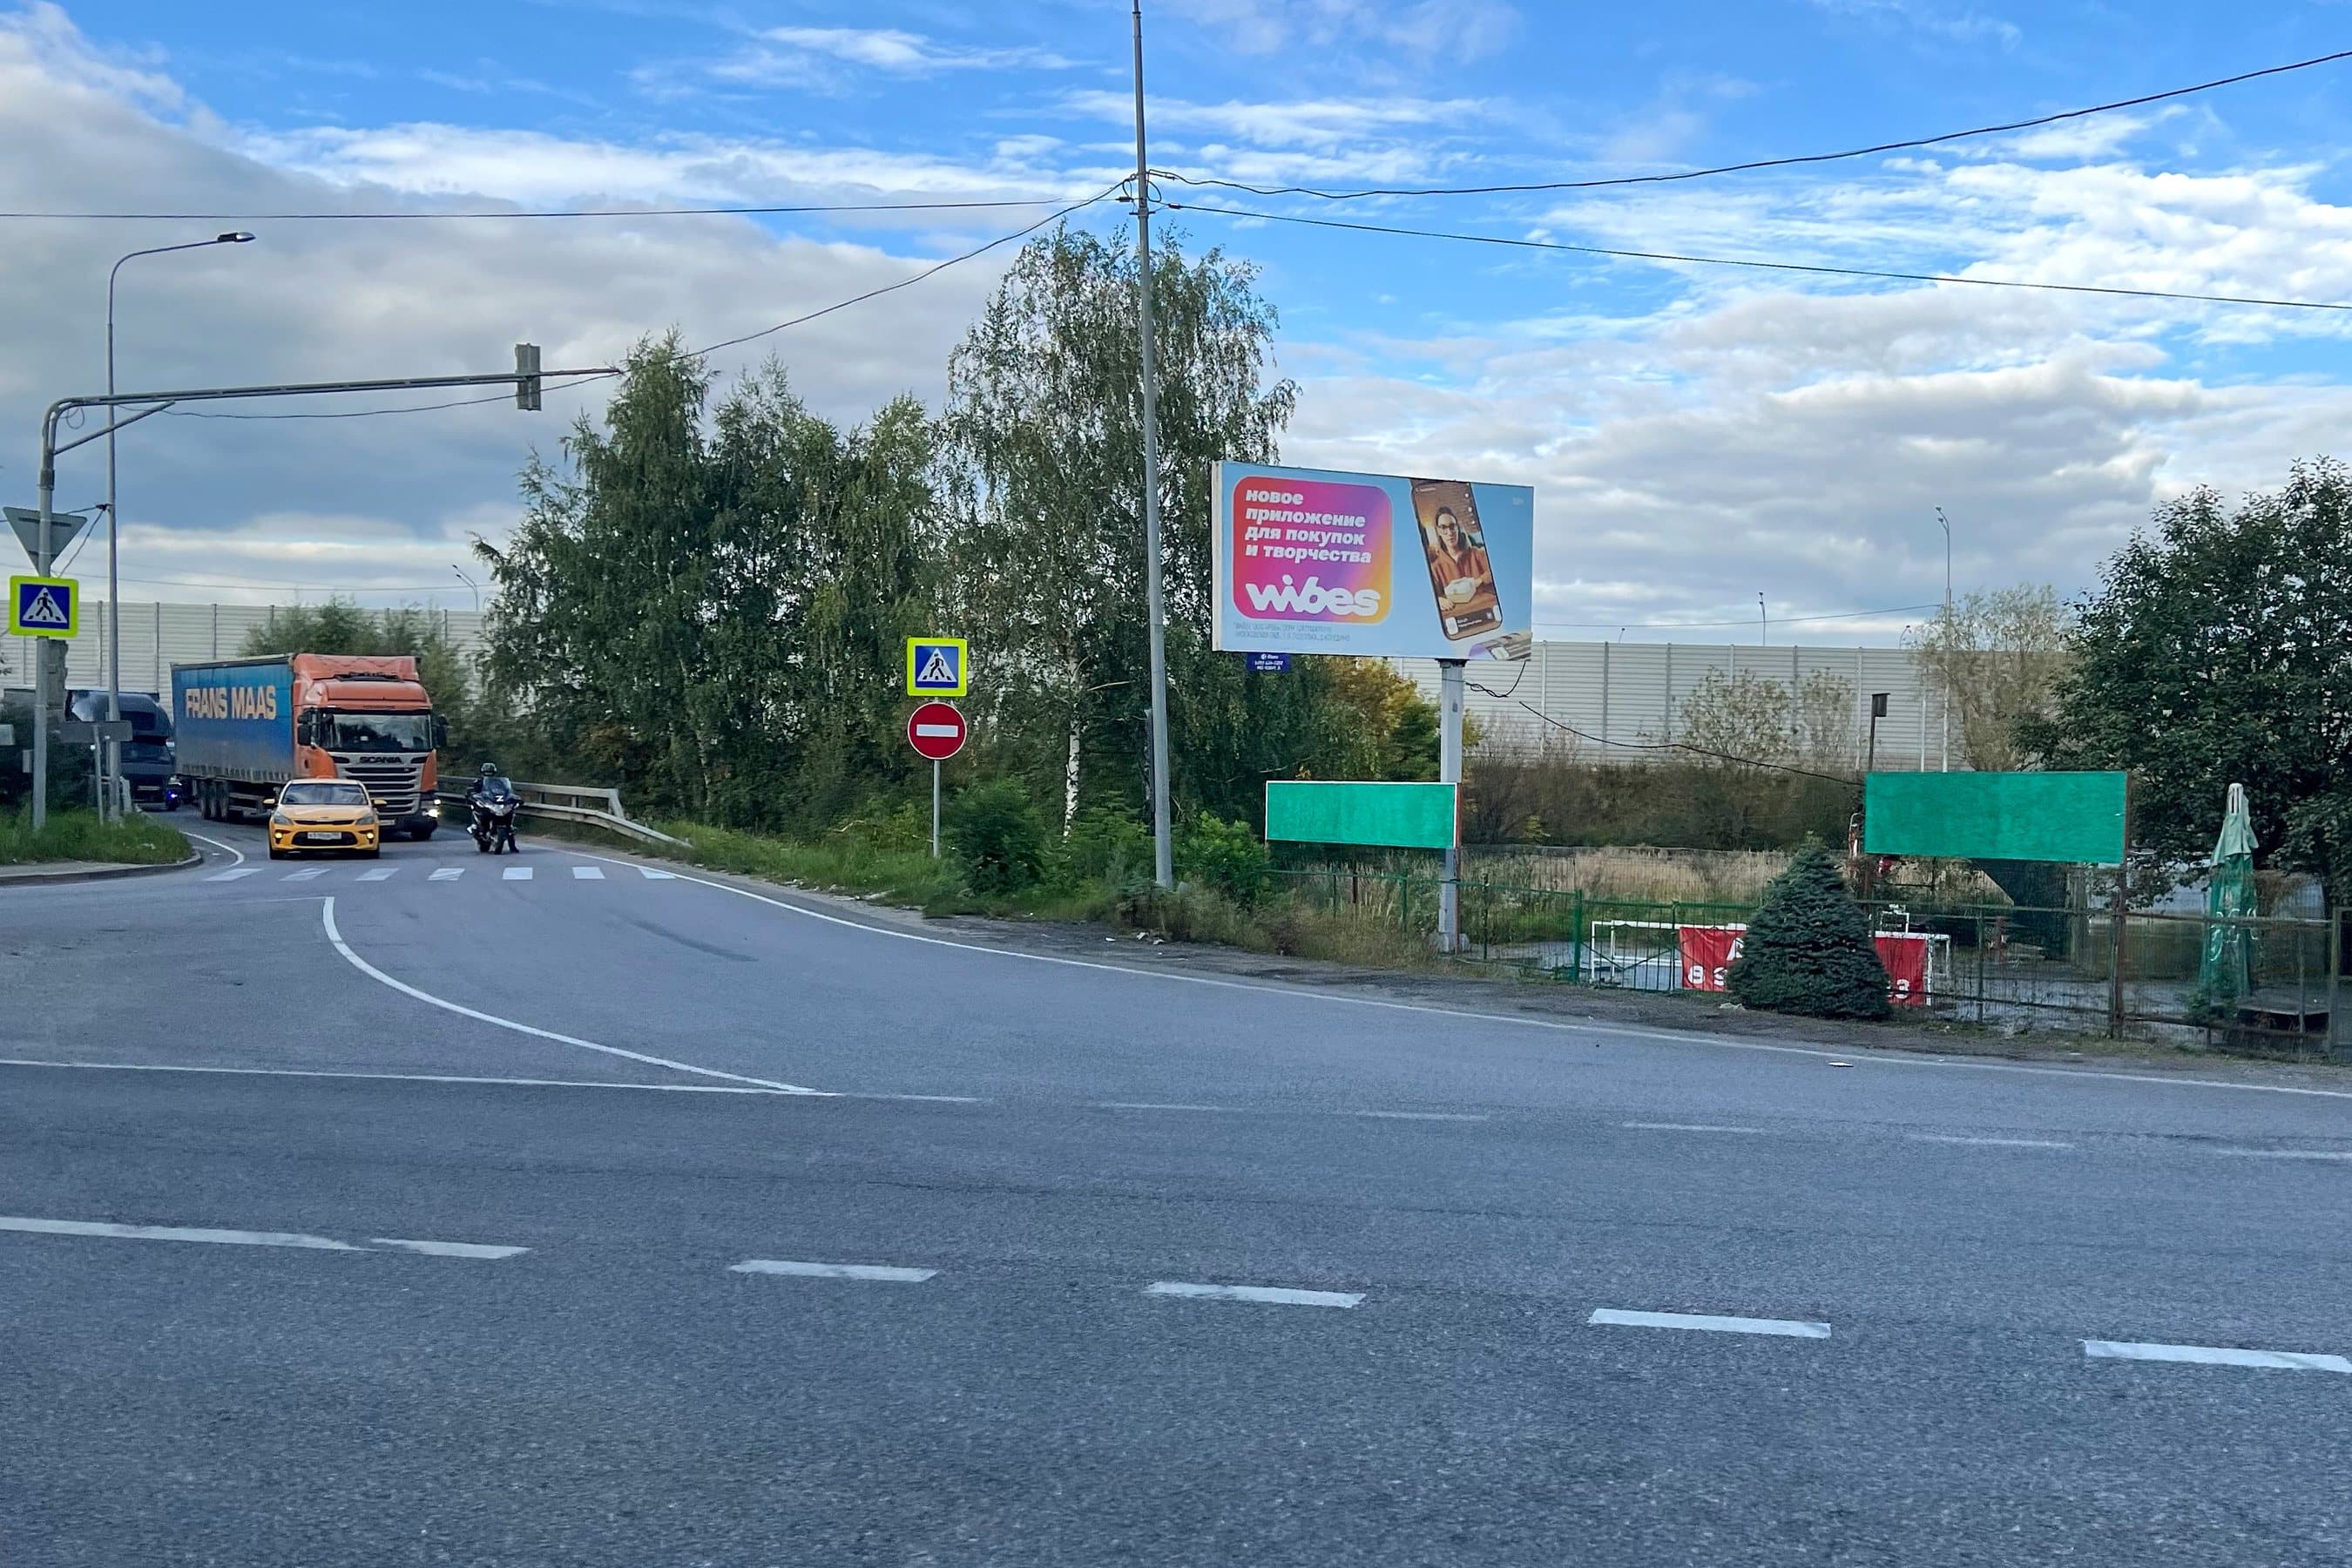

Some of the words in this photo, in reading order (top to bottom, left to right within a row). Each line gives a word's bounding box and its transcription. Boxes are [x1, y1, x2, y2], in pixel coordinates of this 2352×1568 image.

[1246, 490, 1304, 505] новое
[1246, 508, 1366, 527] приложение
[1245, 526, 1281, 541] для
[1286, 529, 1366, 547] покупок
[1246, 544, 1259, 557] и
[1263, 545, 1372, 564] творчества
[1245, 574, 1382, 617] wibes
[186, 687, 227, 719] FRANS
[231, 686, 277, 720] MAAS
[359, 755, 402, 764] SCANIA
